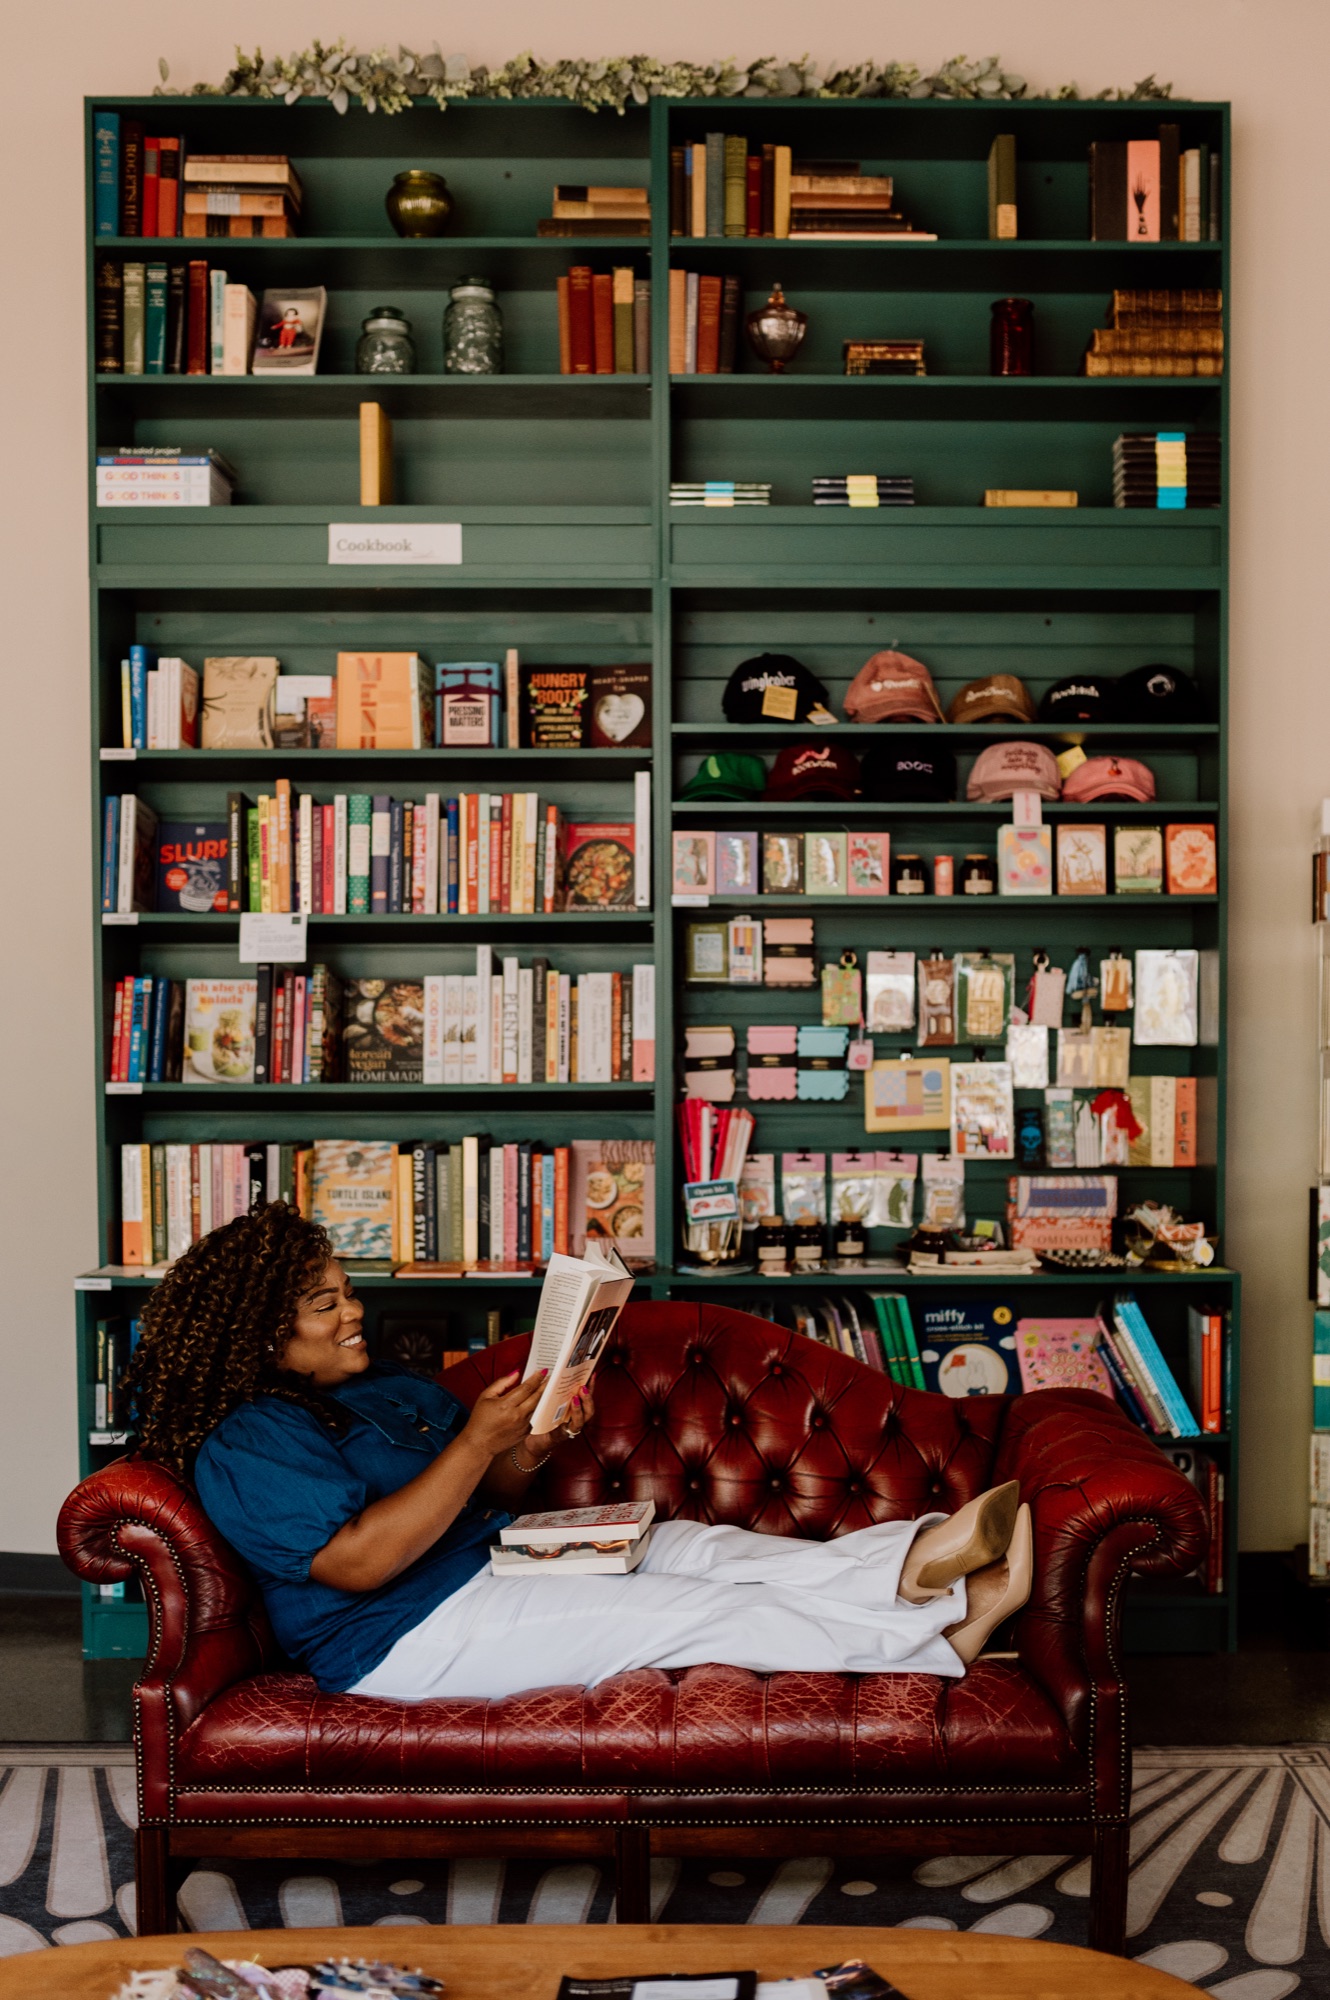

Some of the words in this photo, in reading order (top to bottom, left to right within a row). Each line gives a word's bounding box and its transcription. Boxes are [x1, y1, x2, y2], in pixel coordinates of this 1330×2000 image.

[155, 446, 181, 456] project
[336, 538, 413, 552] Cookbook
[531, 672, 587, 688] HUNGRY
[537, 689, 582, 705] ROOTS
[448, 706, 486, 716] PRESSING
[449, 716, 485, 727] MATTERS
[191, 982, 208, 992] oh
[212, 982, 234, 992] she
[503, 993, 519, 1055] PLENTY
[349, 1048, 392, 1059] korean
[350, 1060, 387, 1071] vegan
[412, 1148, 426, 1203] OHANA
[327, 1189, 359, 1200] TURTLE
[362, 1189, 392, 1200] ISLAND
[414, 1213, 426, 1260] STYLE
[924, 1309, 966, 1324] miffy
